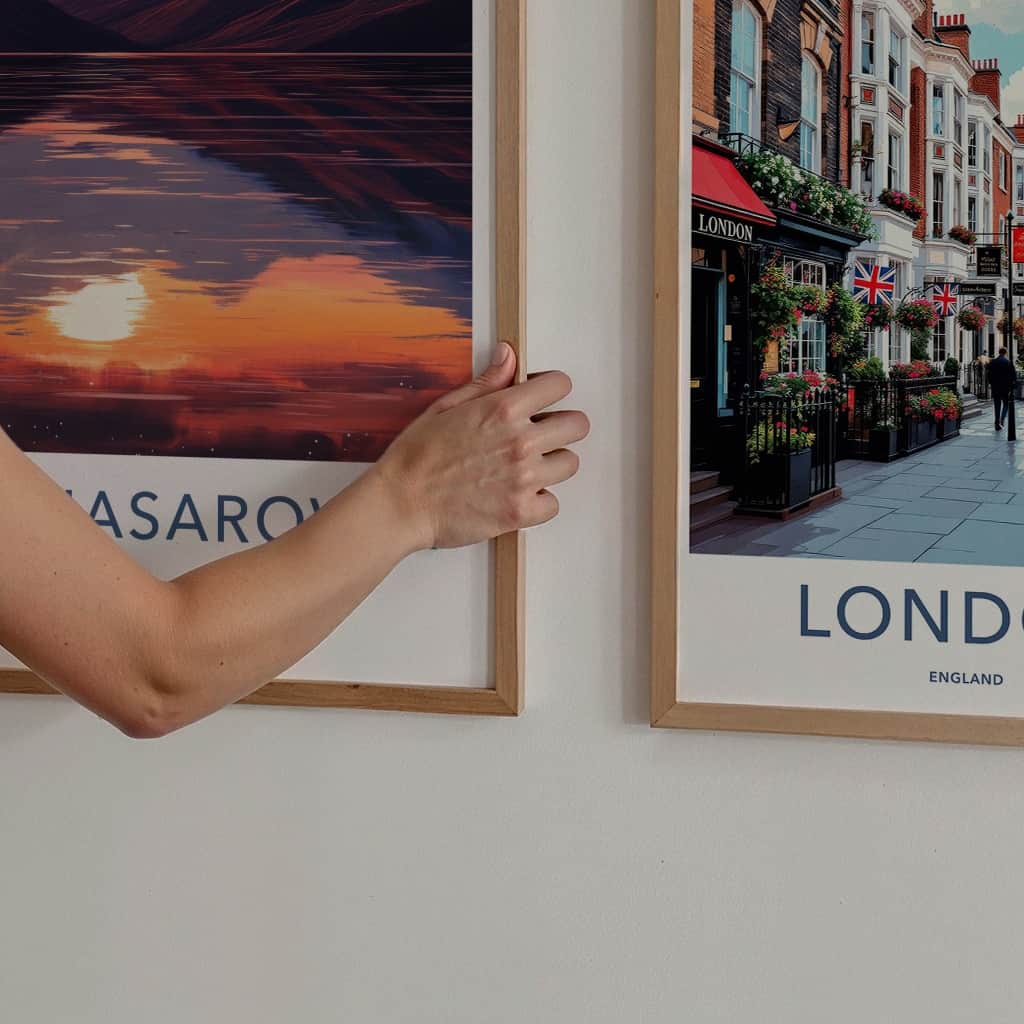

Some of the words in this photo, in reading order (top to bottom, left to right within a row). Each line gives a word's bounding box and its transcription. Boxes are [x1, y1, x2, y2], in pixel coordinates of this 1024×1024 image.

[698, 213, 753, 242] LONDON
[65, 489, 320, 543] ASARO
[800, 584, 1024, 645] LOND
[928, 671, 1005, 686] ENGLAND
